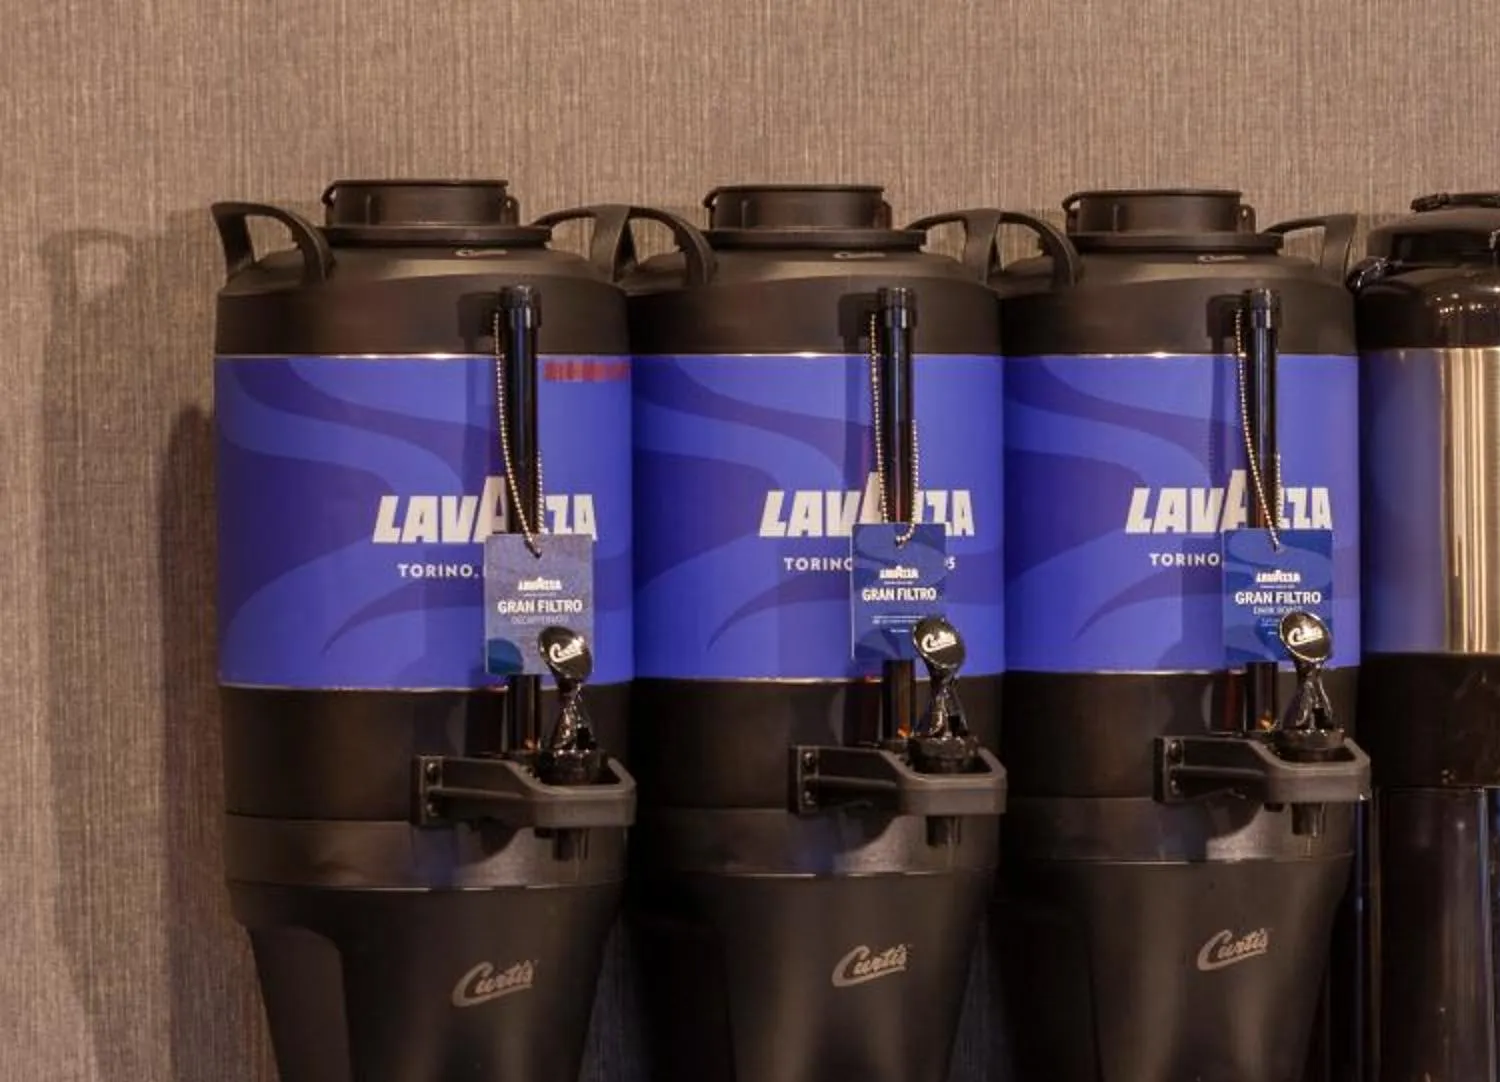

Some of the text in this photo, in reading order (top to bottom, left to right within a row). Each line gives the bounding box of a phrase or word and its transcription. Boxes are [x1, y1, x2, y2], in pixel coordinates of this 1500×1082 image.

[372, 476, 598, 543] LAVAZA
[759, 472, 975, 537] LAVZA
[862, 587, 937, 601] GRAN FILTRO
[1235, 591, 1322, 604] GRAN FILTRO
[497, 599, 583, 614] GRAN FILTRO
